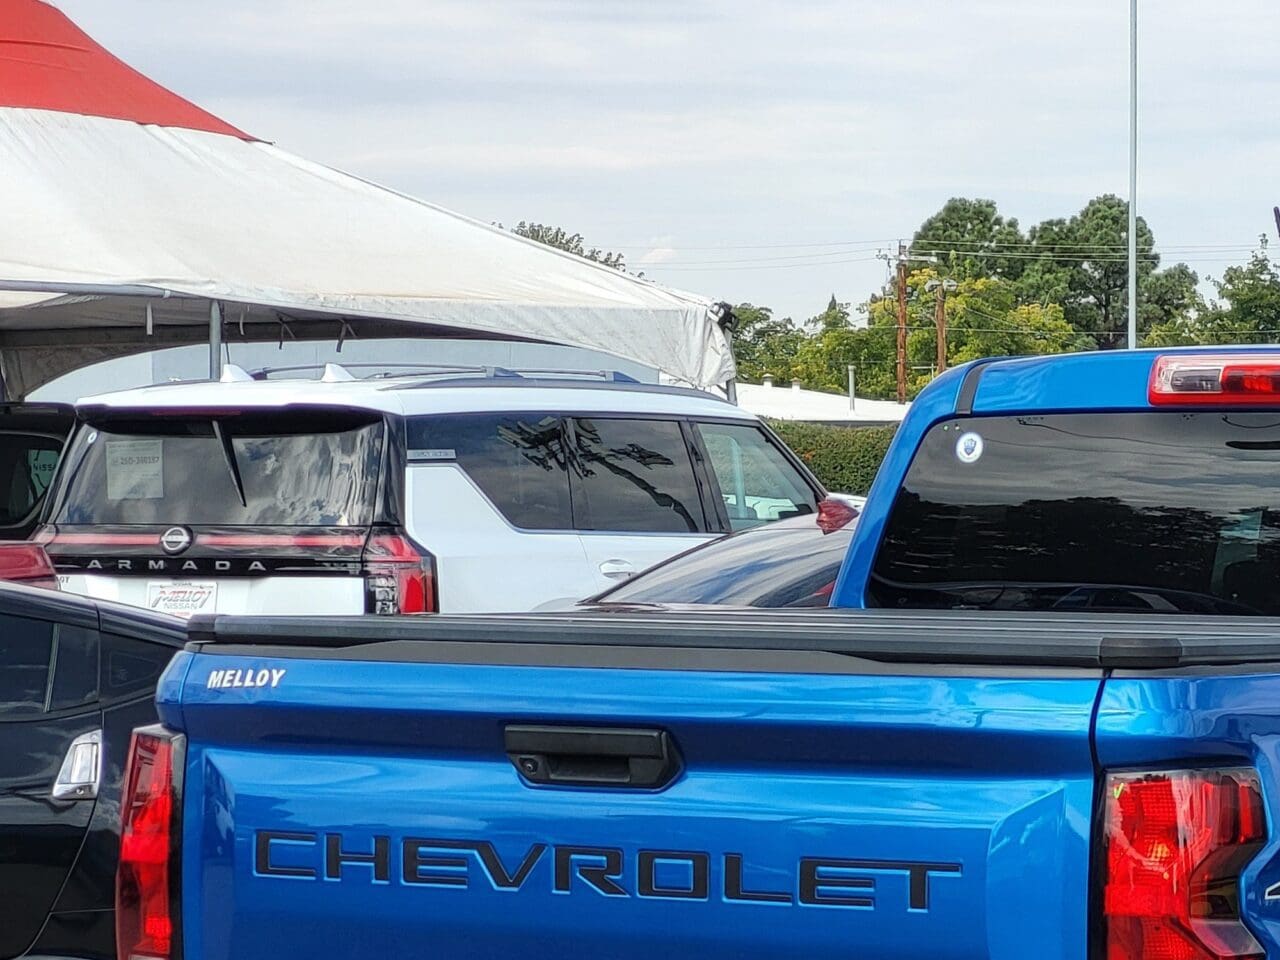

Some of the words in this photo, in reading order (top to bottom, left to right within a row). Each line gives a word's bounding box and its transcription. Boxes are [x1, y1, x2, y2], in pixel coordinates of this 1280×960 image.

[87, 559, 267, 571] ARMADA
[206, 668, 287, 690] MELLOY
[253, 829, 963, 914] CHEVROLET
